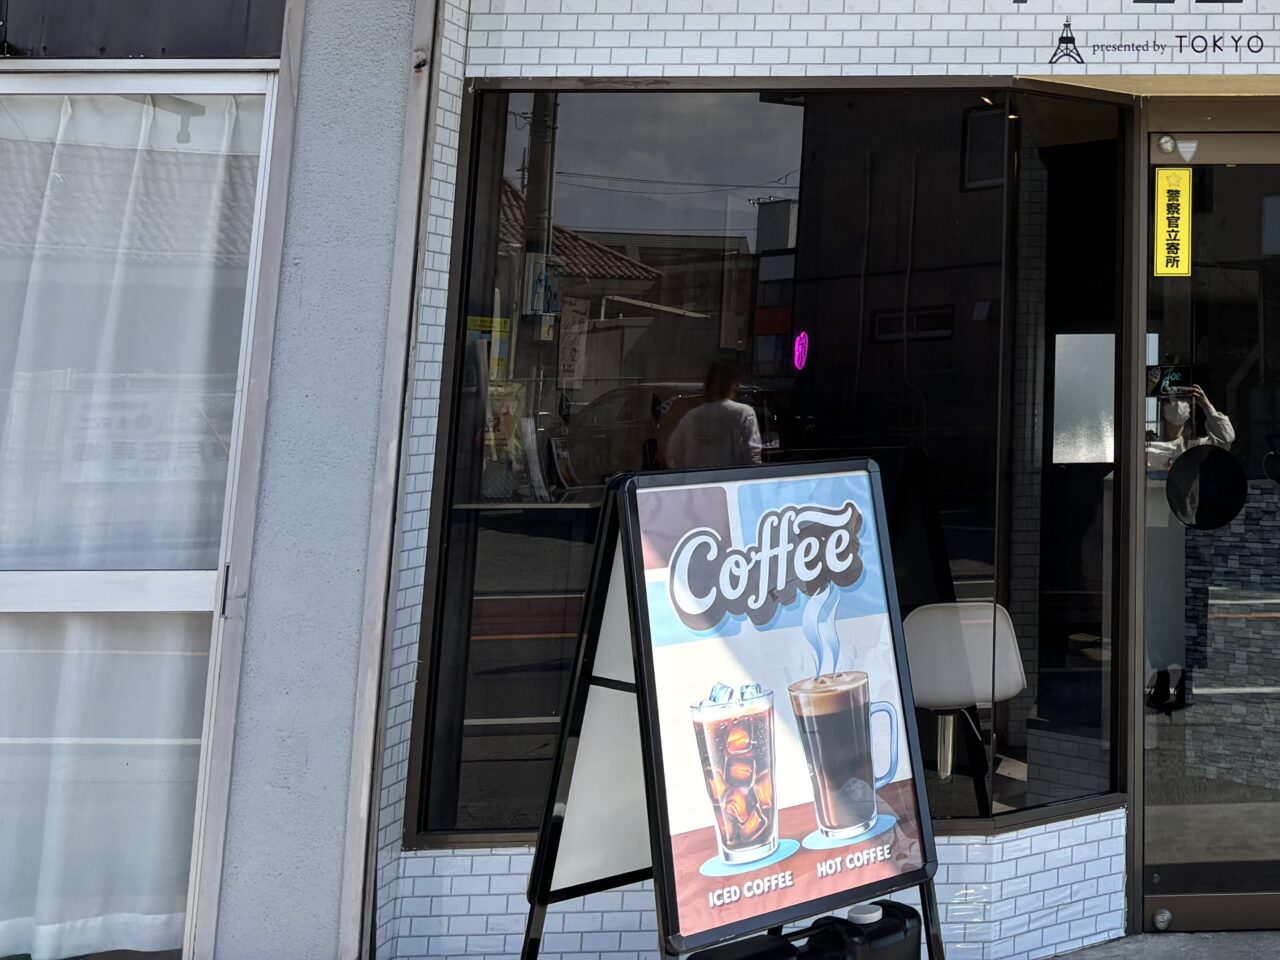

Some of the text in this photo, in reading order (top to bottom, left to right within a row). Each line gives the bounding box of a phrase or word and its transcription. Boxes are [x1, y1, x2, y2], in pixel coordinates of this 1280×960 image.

[1092, 40, 1149, 55] presented
[1153, 40, 1167, 55] by
[1175, 34, 1264, 54] TOKYO
[1165, 189, 1181, 269] 警察官立寄所
[670, 501, 858, 618] Coffee
[816, 844, 892, 878] HOT COFFEE
[708, 870, 794, 908] ICED COFFEE
